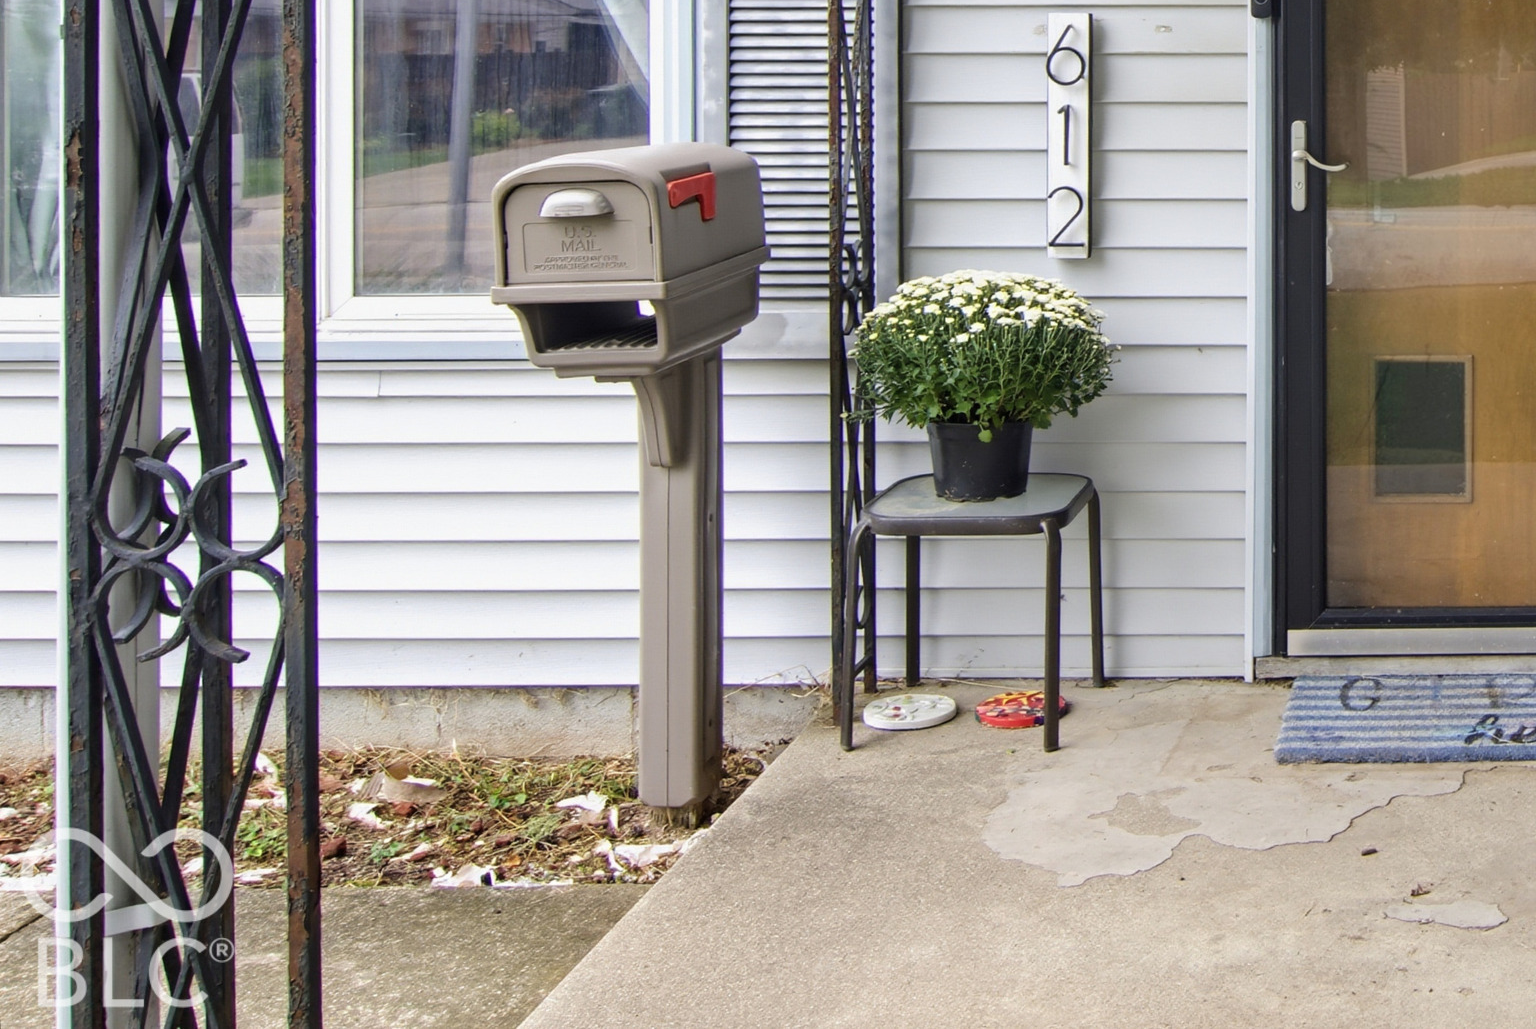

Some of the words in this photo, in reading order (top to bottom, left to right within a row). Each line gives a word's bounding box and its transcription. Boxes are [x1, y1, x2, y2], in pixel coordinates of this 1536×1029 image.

[1046, 23, 1086, 247] 612
[564, 225, 597, 238] U.S.
[561, 239, 602, 252] MAIL
